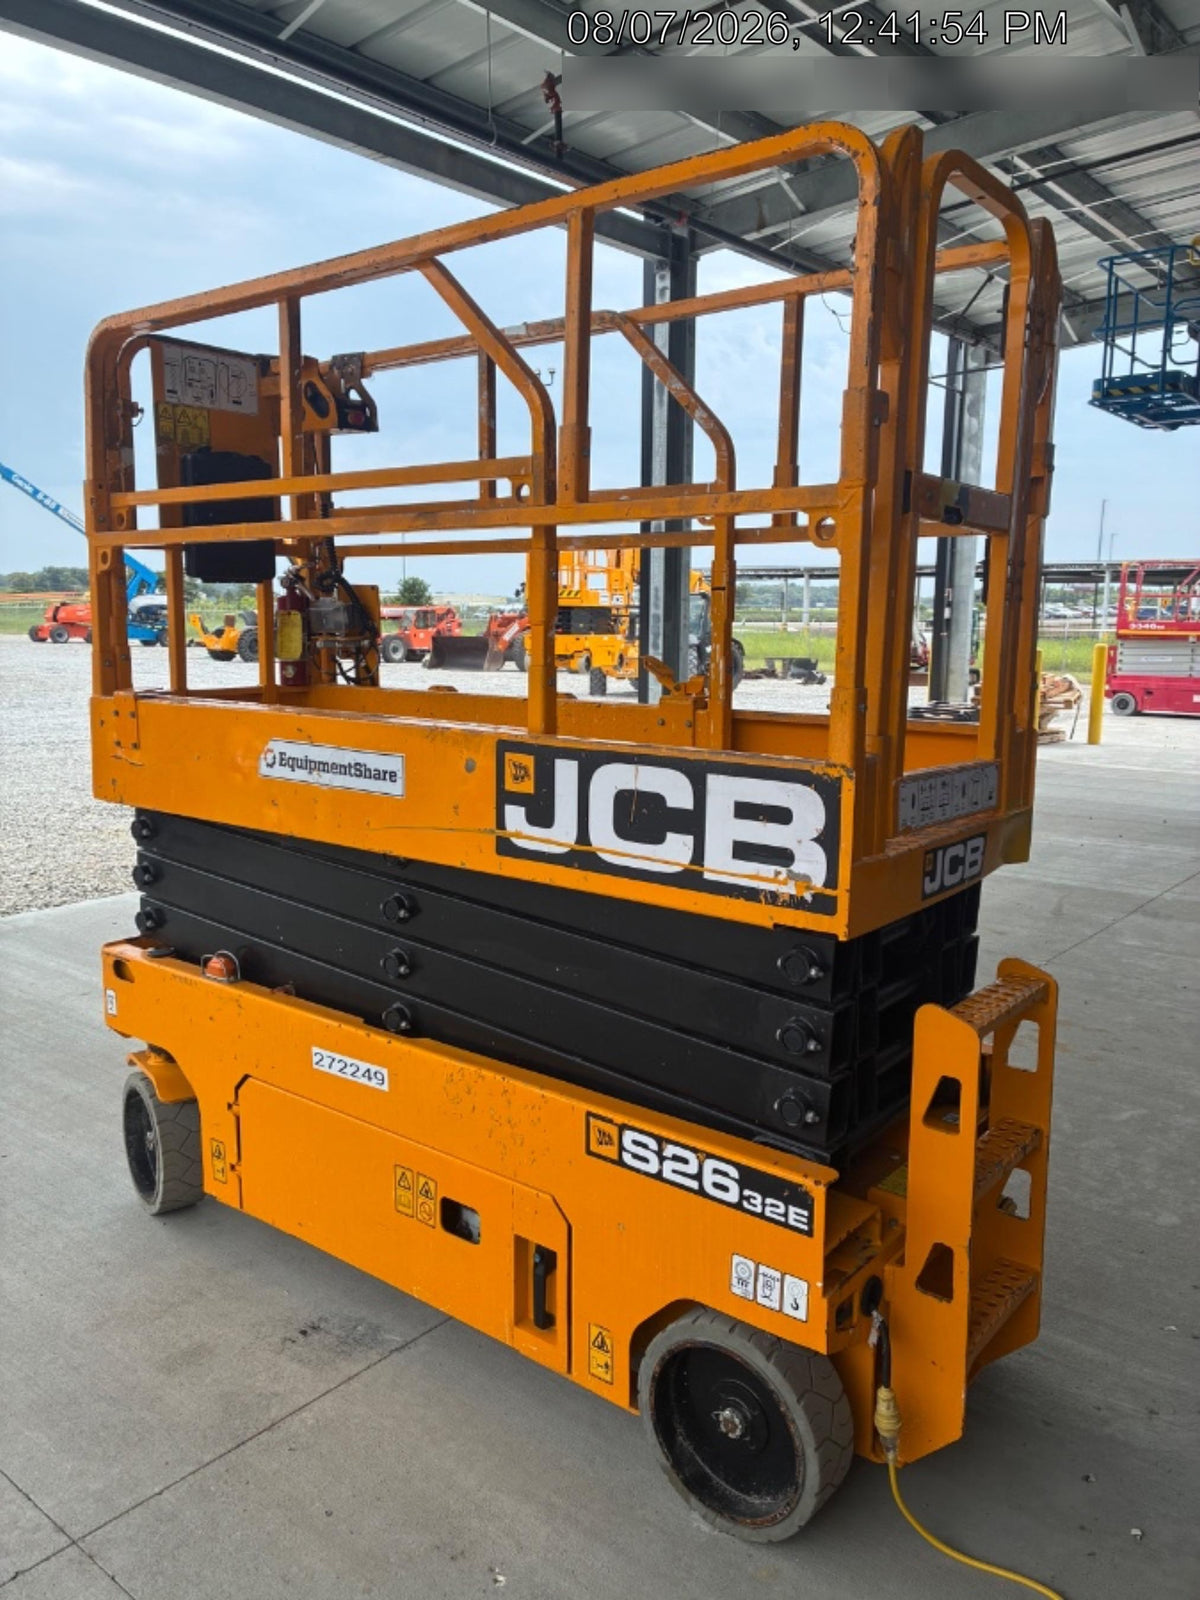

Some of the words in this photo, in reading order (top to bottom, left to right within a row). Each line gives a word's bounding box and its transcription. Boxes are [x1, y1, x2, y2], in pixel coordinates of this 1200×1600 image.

[278, 750, 398, 784] EquipmentShare
[504, 758, 828, 898] JCB
[924, 836, 985, 896] JCB
[313, 1051, 386, 1087] 272249
